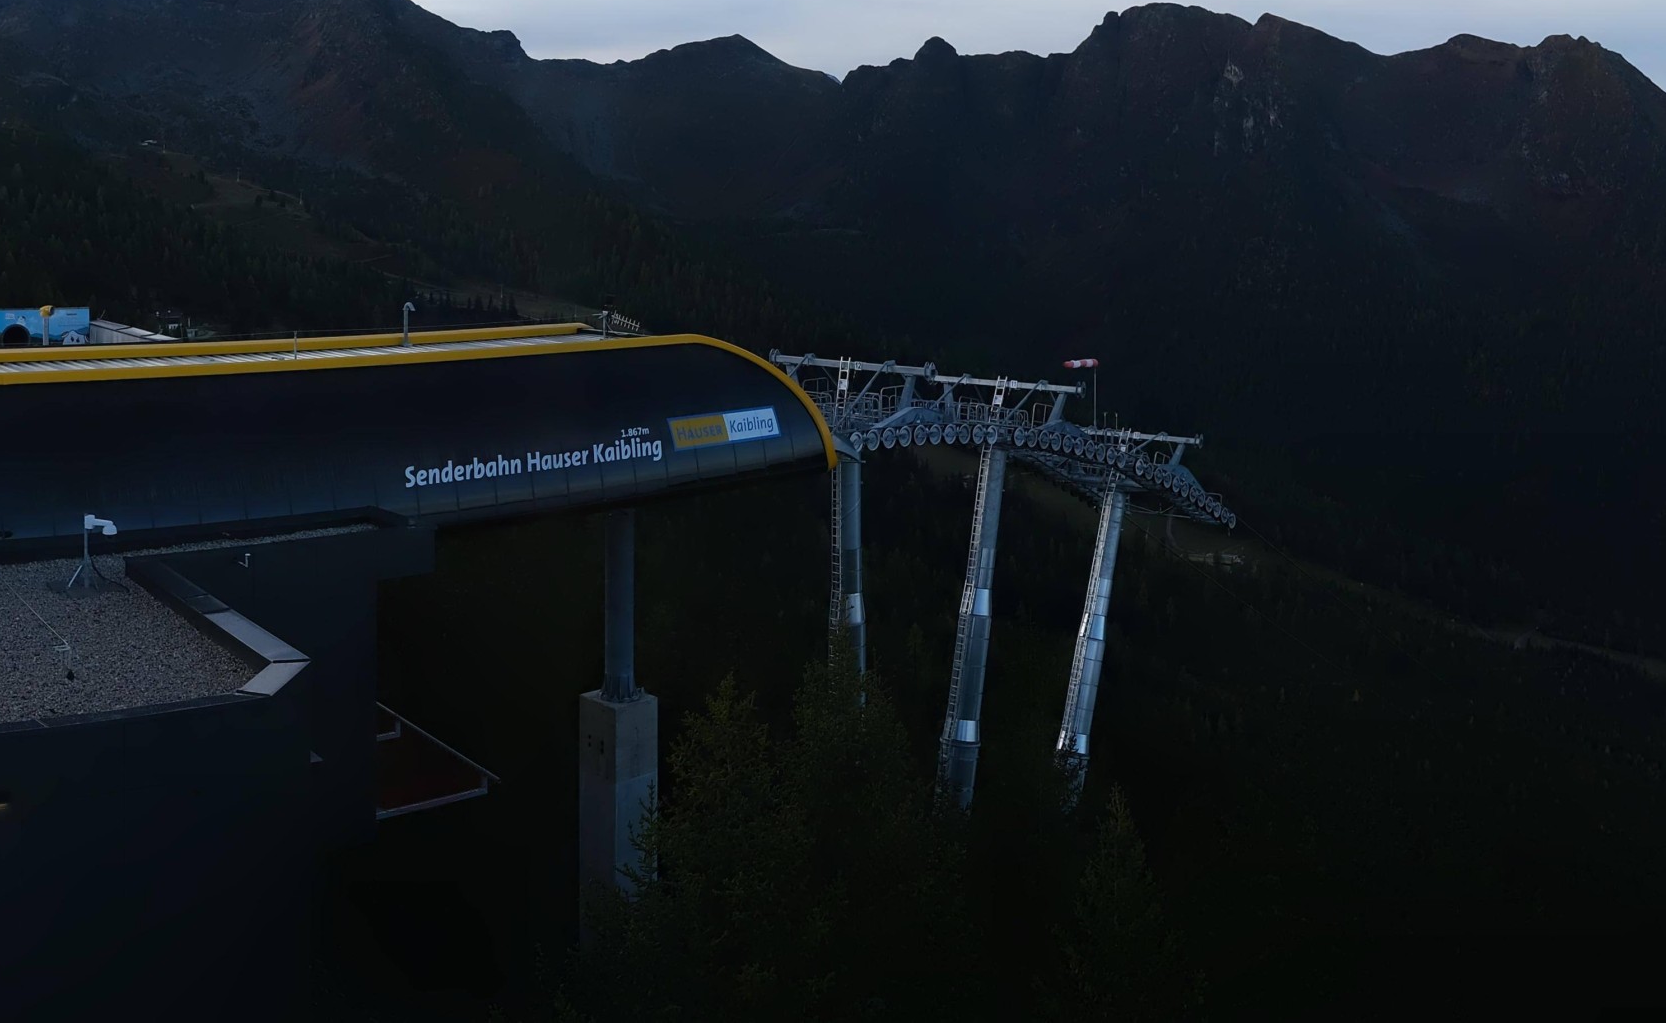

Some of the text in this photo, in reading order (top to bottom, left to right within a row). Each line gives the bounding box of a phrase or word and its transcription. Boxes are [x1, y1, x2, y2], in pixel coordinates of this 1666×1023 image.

[620, 427, 650, 438] 1.867m
[676, 417, 774, 441] HAUSER Kaibling
[405, 438, 662, 488] Senderbahn Hauser Kaibling
